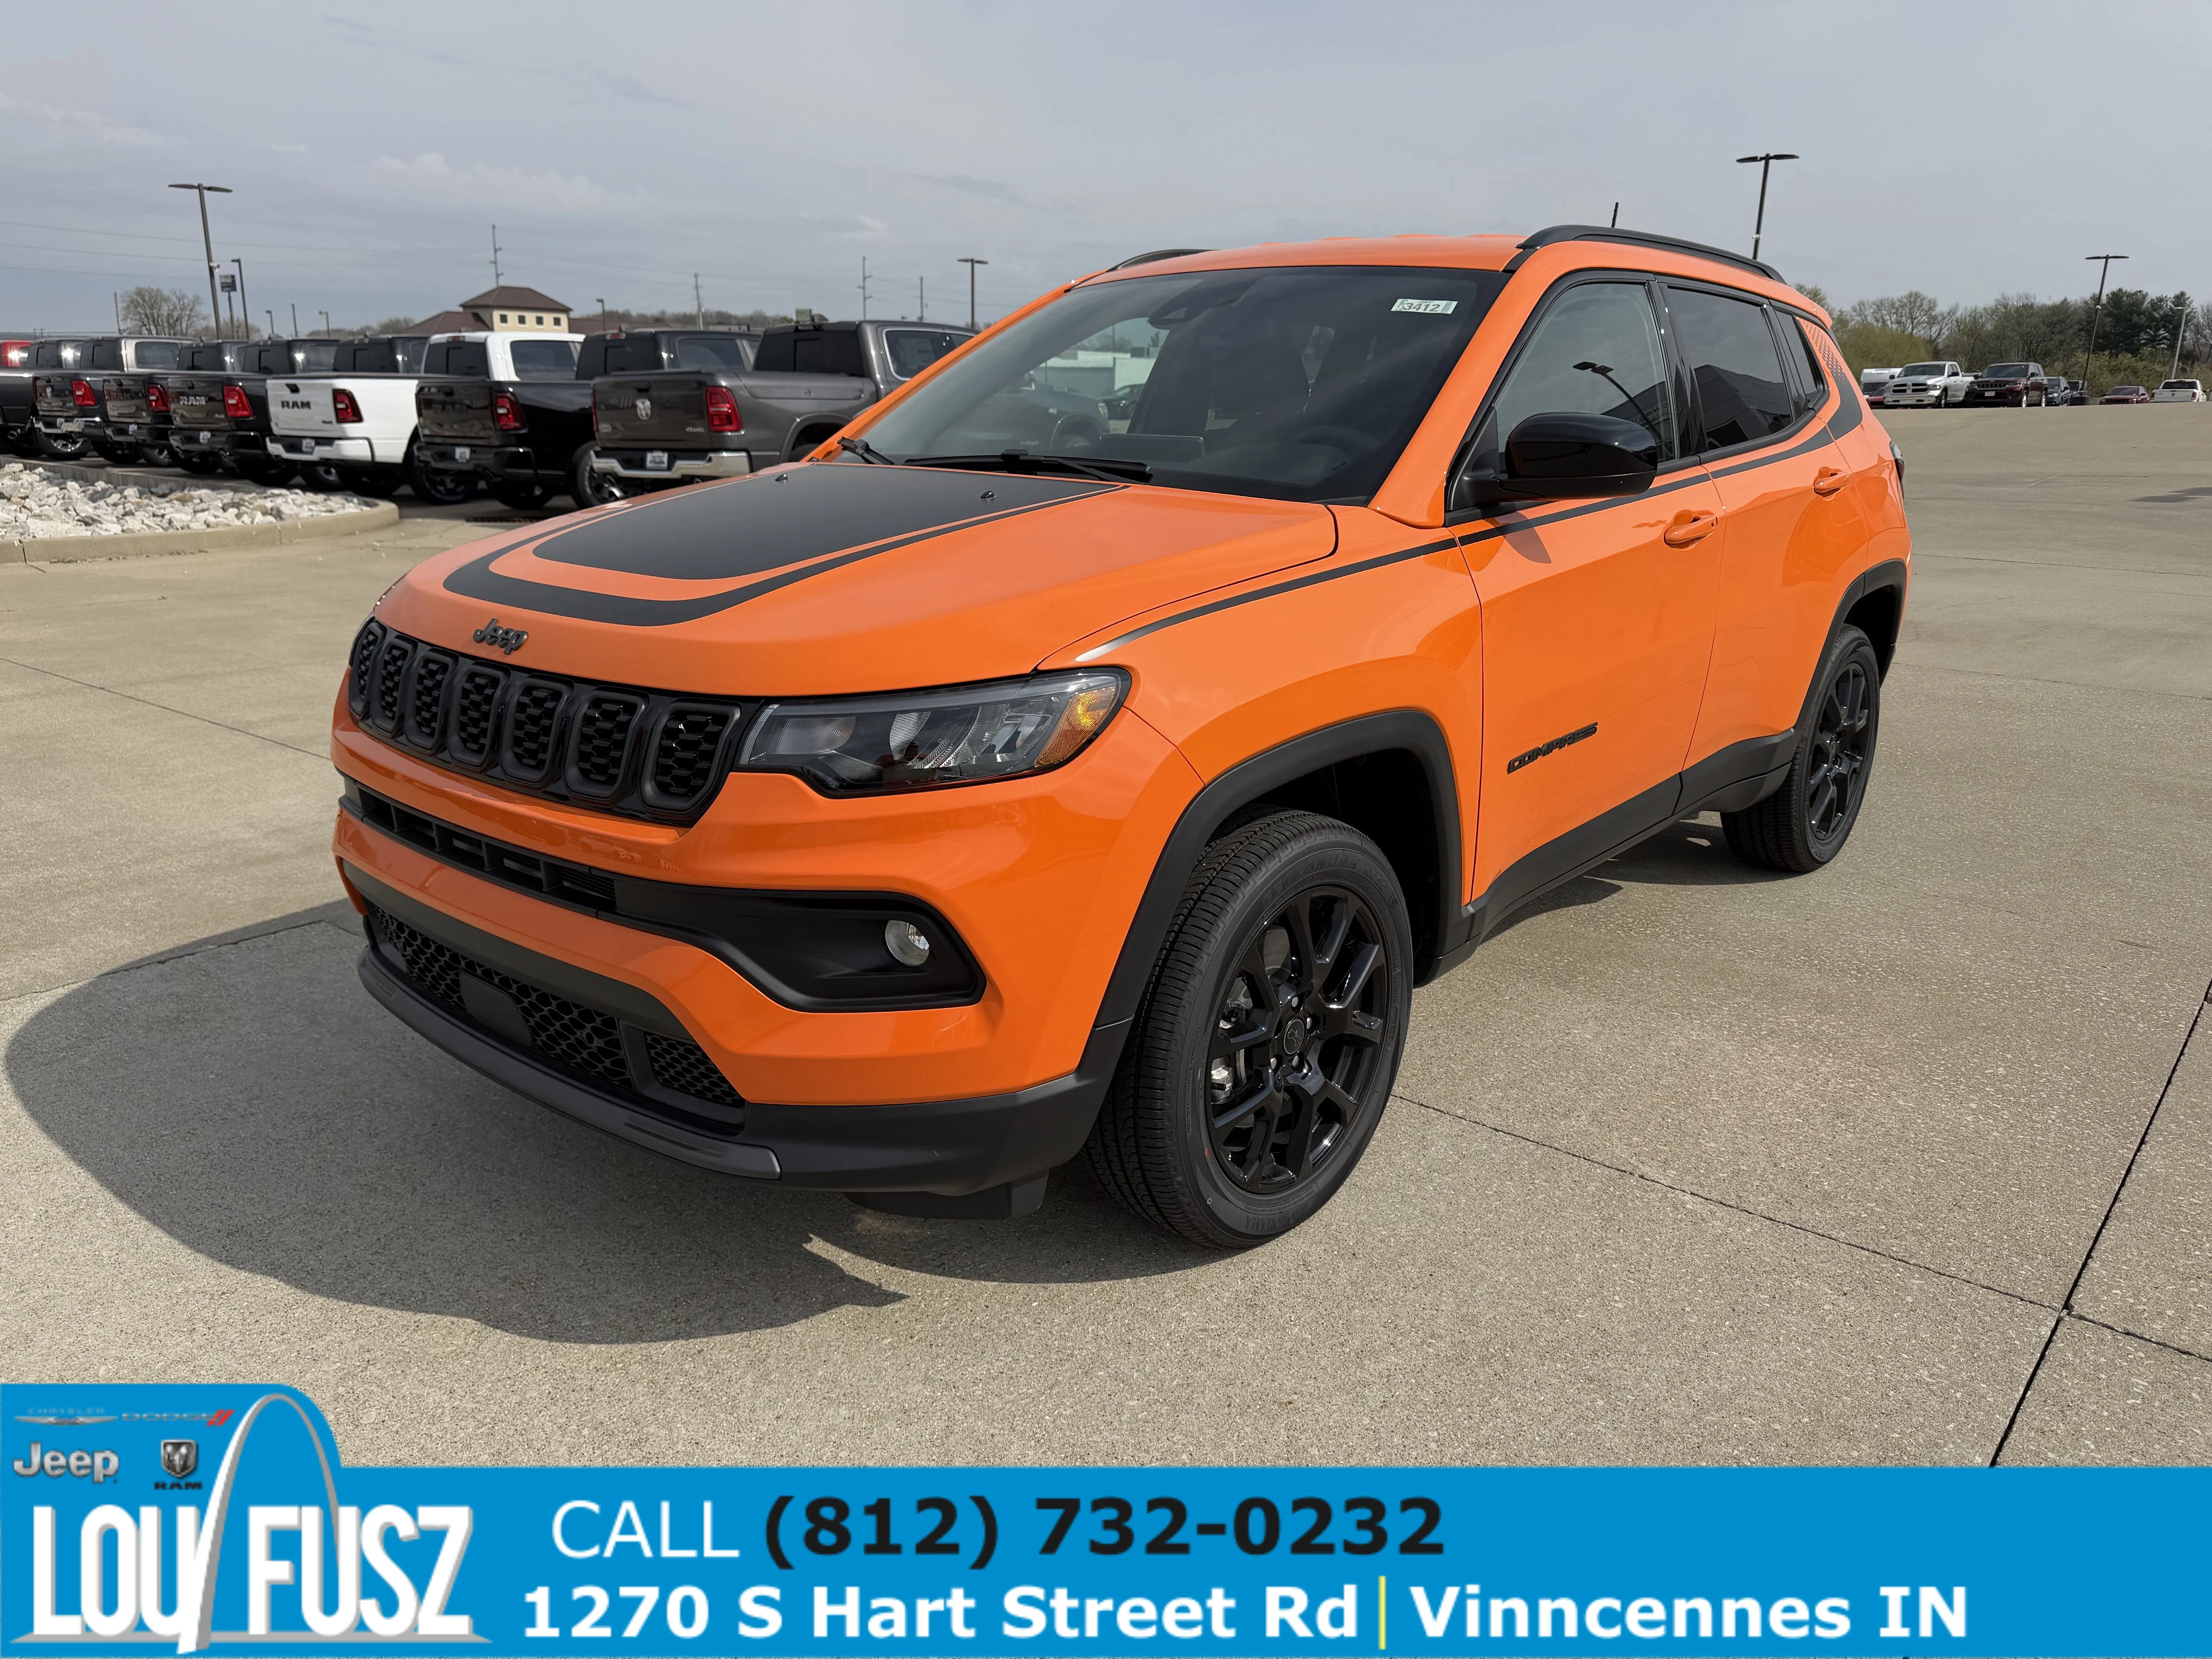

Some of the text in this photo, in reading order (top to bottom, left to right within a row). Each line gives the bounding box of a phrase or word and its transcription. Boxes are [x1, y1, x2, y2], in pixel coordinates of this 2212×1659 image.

[1402, 302, 1440, 312] 3412
[179, 395, 206, 405] RAM
[281, 400, 311, 410] RAM
[473, 618, 529, 655] Jeep
[1507, 722, 1598, 775] COMPASS
